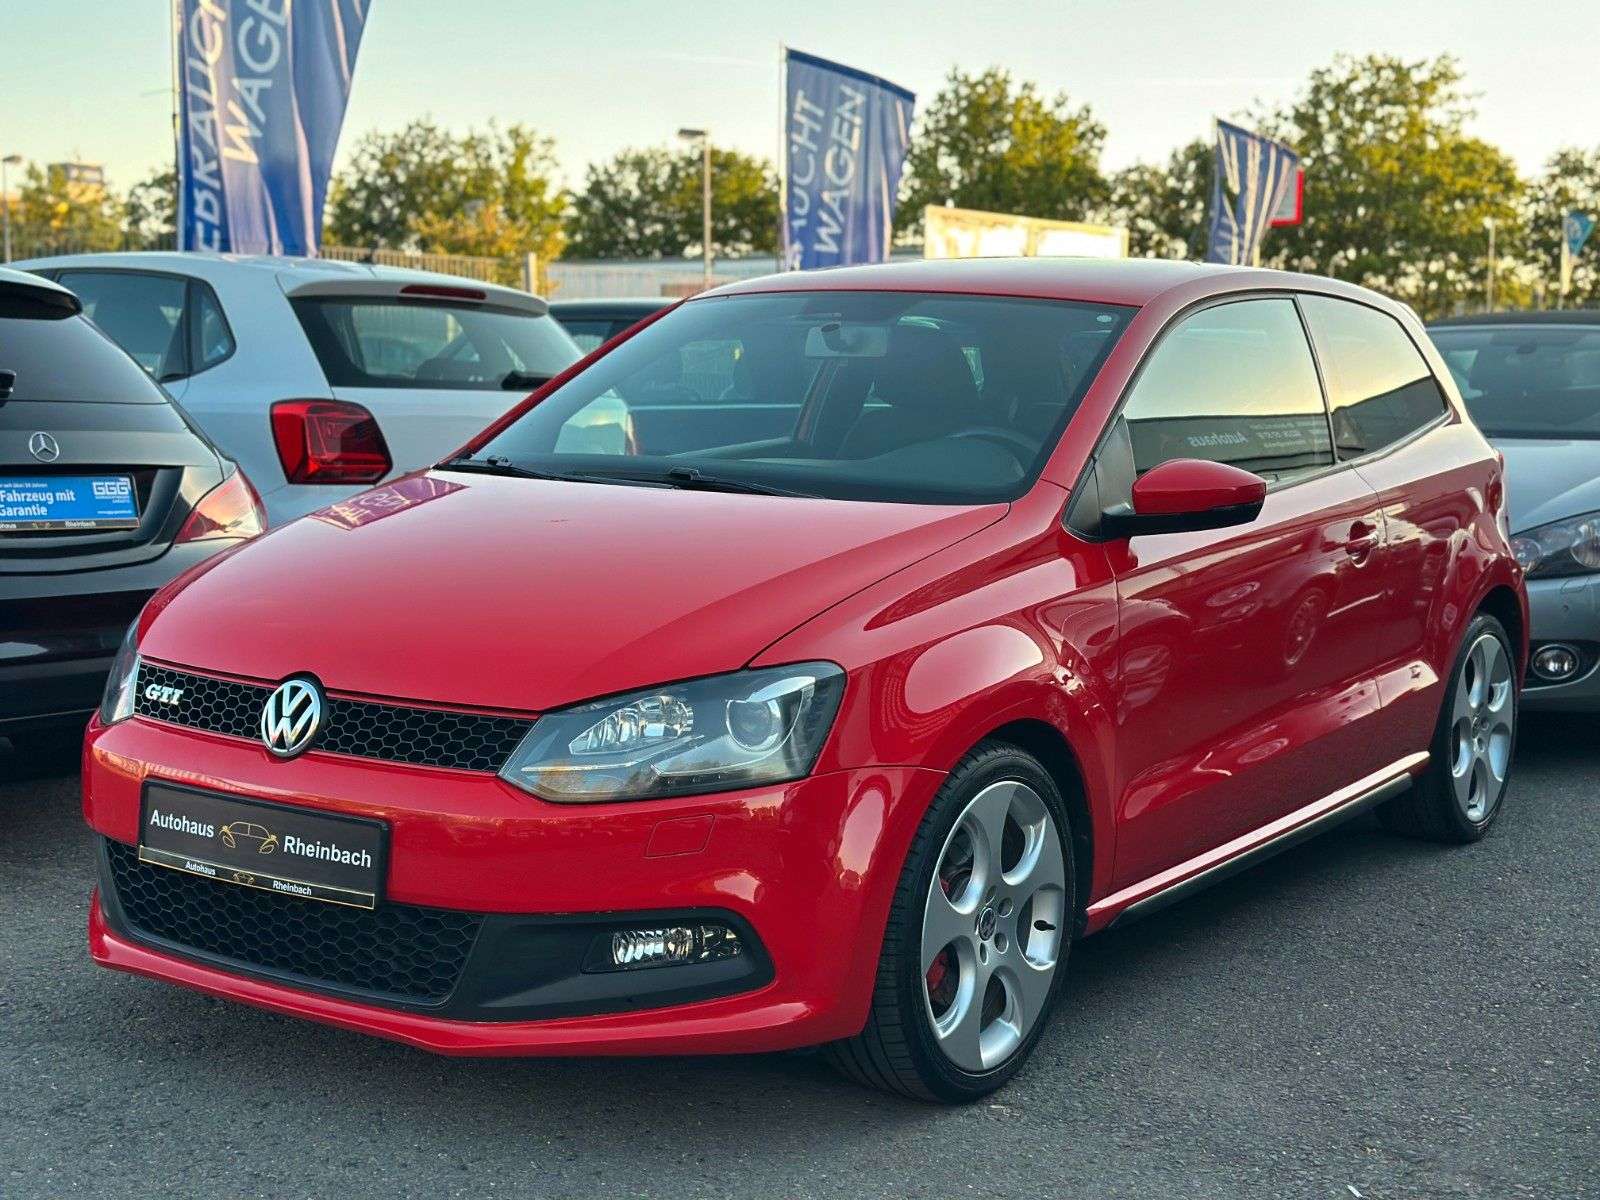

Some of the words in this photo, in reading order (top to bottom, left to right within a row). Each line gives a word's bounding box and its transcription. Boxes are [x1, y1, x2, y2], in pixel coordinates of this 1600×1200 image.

[813, 83, 867, 254] WAGEN
[0, 489, 54, 504] Fahrzeug
[56, 489, 76, 501] mit
[145, 683, 184, 706] GTI
[150, 809, 214, 838] Autohaus
[283, 835, 372, 868] Rheinbach
[185, 861, 216, 876] Autohaus
[272, 880, 312, 896] Rheinbach
